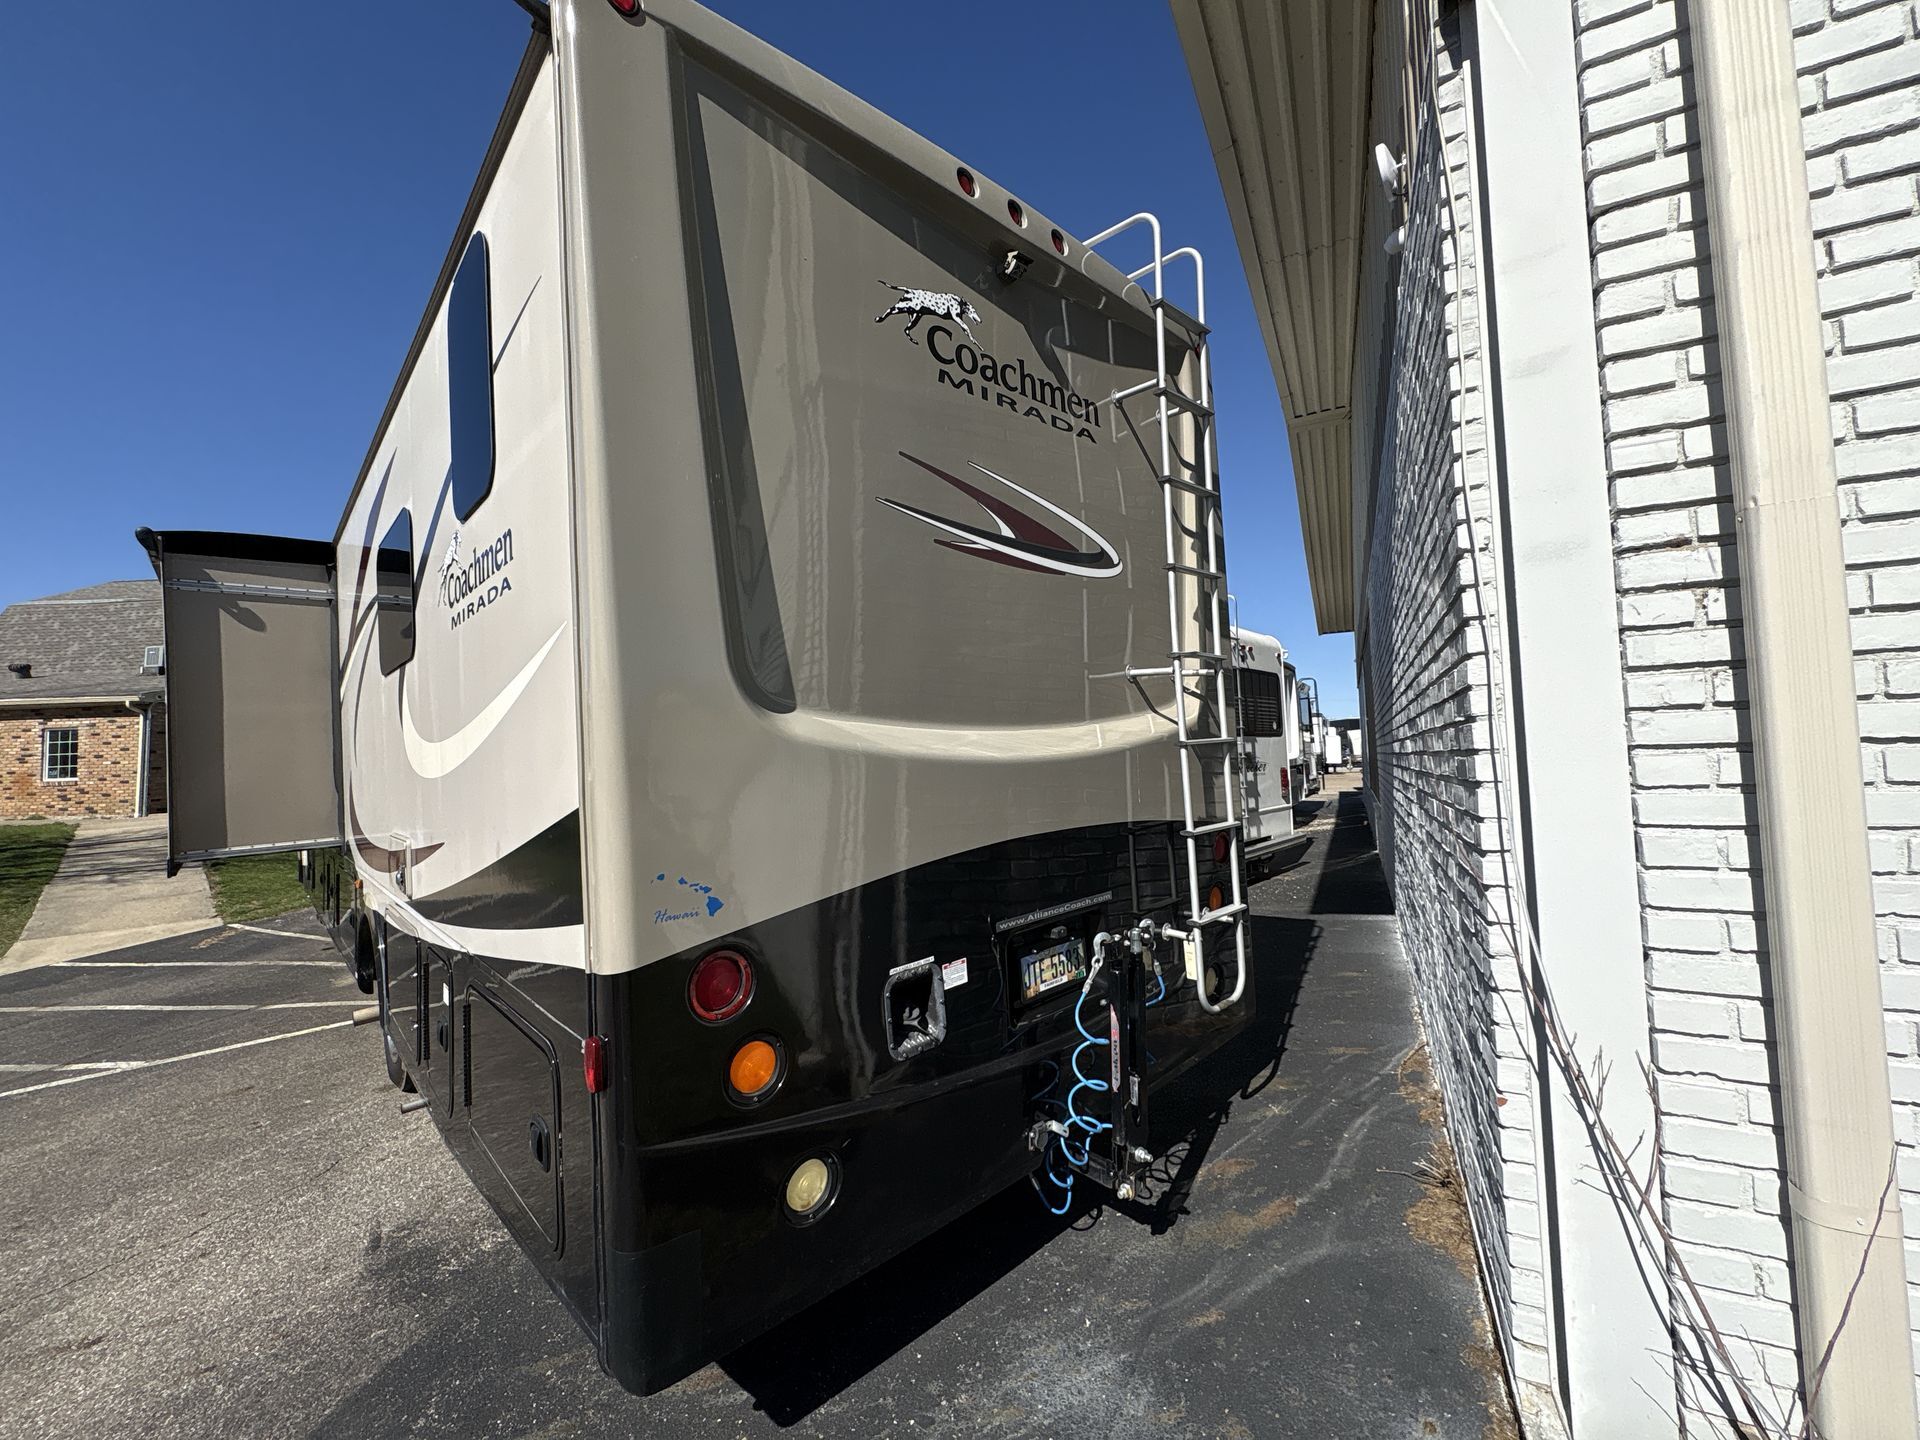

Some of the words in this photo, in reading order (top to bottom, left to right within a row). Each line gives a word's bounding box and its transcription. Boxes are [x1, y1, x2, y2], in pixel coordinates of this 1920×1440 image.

[926, 325, 1101, 428] Coachmen
[937, 368, 1097, 444] MIRADA
[447, 528, 514, 609] Coachmen
[451, 576, 512, 631] MIRADA
[654, 907, 700, 924] Hawaii
[999, 893, 1111, 930] www.AllianceCoach.com
